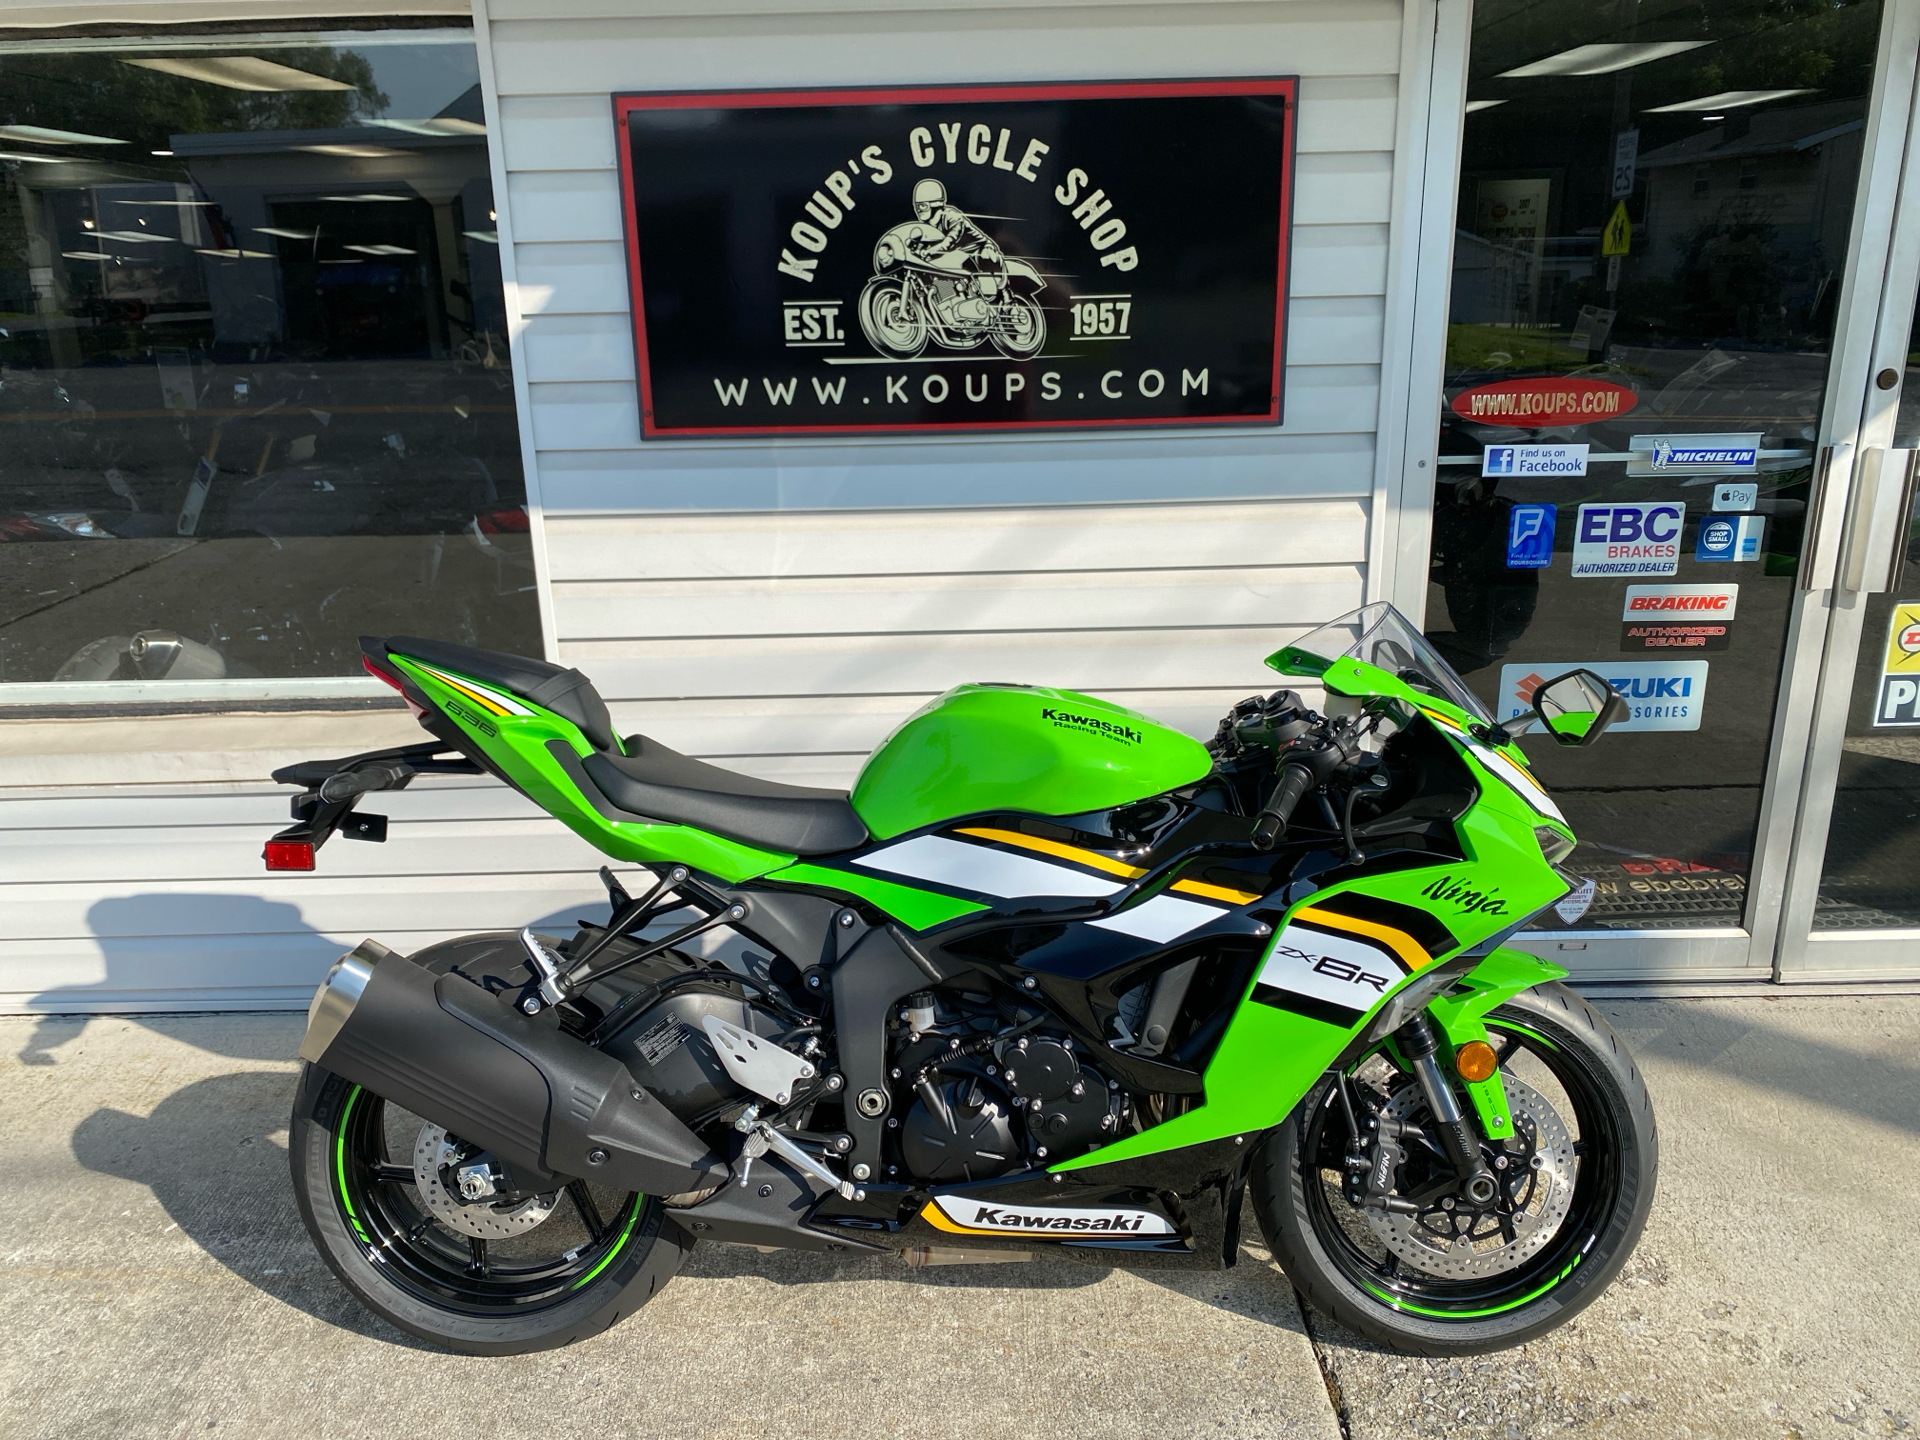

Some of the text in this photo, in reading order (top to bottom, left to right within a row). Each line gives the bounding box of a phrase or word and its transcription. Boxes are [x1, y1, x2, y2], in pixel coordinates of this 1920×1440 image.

[778, 122, 1139, 283] KOUP'S CYCLE SHOP
[784, 308, 845, 341] EST.
[1070, 302, 1131, 335] 1957
[713, 367, 1209, 407] WWW.KOUPS.COM
[1471, 391, 1620, 416] WWW.KOUPS.COM
[1519, 458, 1582, 472] Facebook
[1520, 449, 1539, 457] Find
[1673, 452, 1753, 462] MICHELIN
[1731, 490, 1753, 504] Pay
[1580, 507, 1680, 543] EBC
[1607, 545, 1676, 558] BRAKES
[1577, 562, 1676, 573] AUTHORIZED DEALER
[1629, 596, 1730, 611] BRAKING
[1627, 626, 1727, 637] AUTHORIZED
[1645, 637, 1707, 647] DEALER
[1607, 677, 1692, 698] ZUKI
[445, 700, 497, 738] 636
[1631, 705, 1688, 718] SORIES
[1042, 707, 1142, 745] Kawasaki
[1053, 721, 1131, 746] Racing Team
[1421, 875, 1508, 916] Ninja
[1277, 945, 1389, 993] ZX-6R
[974, 1207, 1145, 1231] Kawasaki
